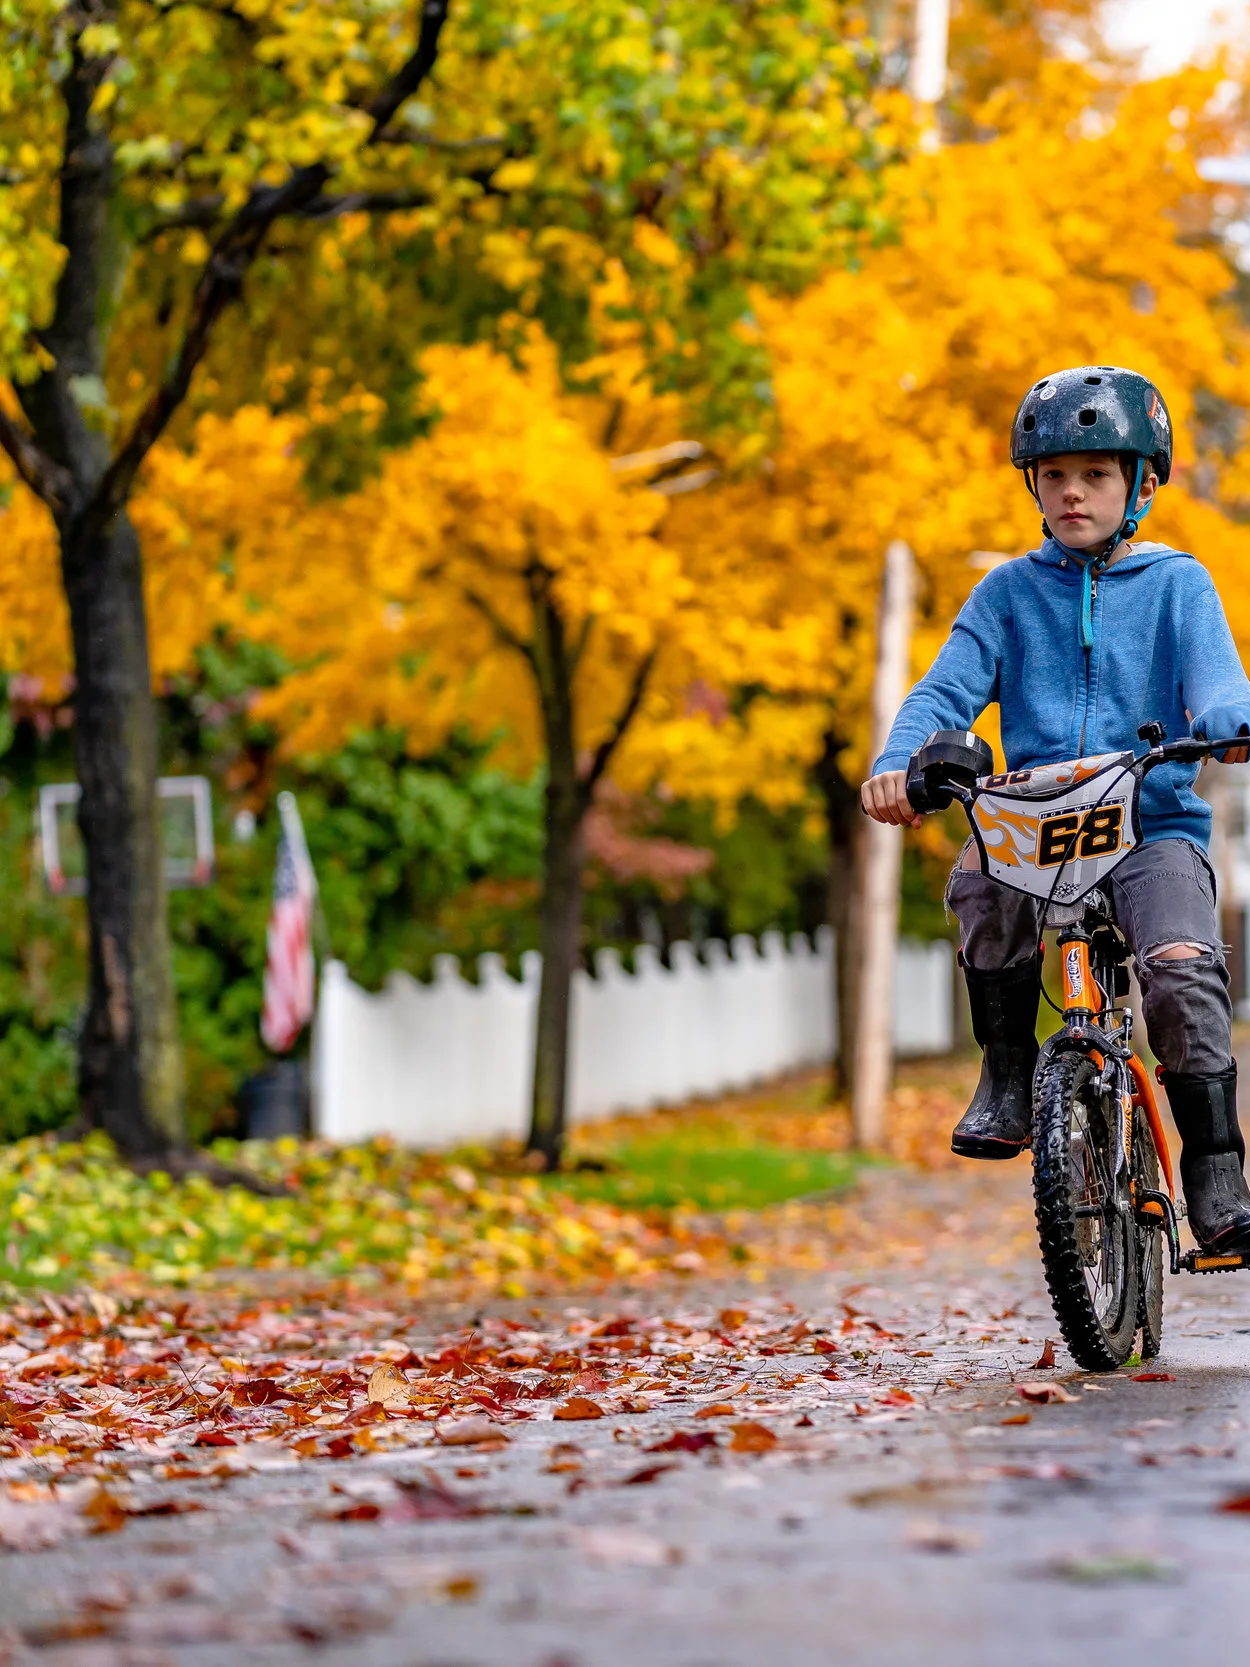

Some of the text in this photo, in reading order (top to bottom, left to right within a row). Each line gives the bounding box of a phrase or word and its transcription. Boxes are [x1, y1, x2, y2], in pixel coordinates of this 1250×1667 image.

[1041, 799, 1125, 819] HOT WHELS
[1036, 804, 1124, 868] 68
[1067, 960, 1080, 974] HOT
